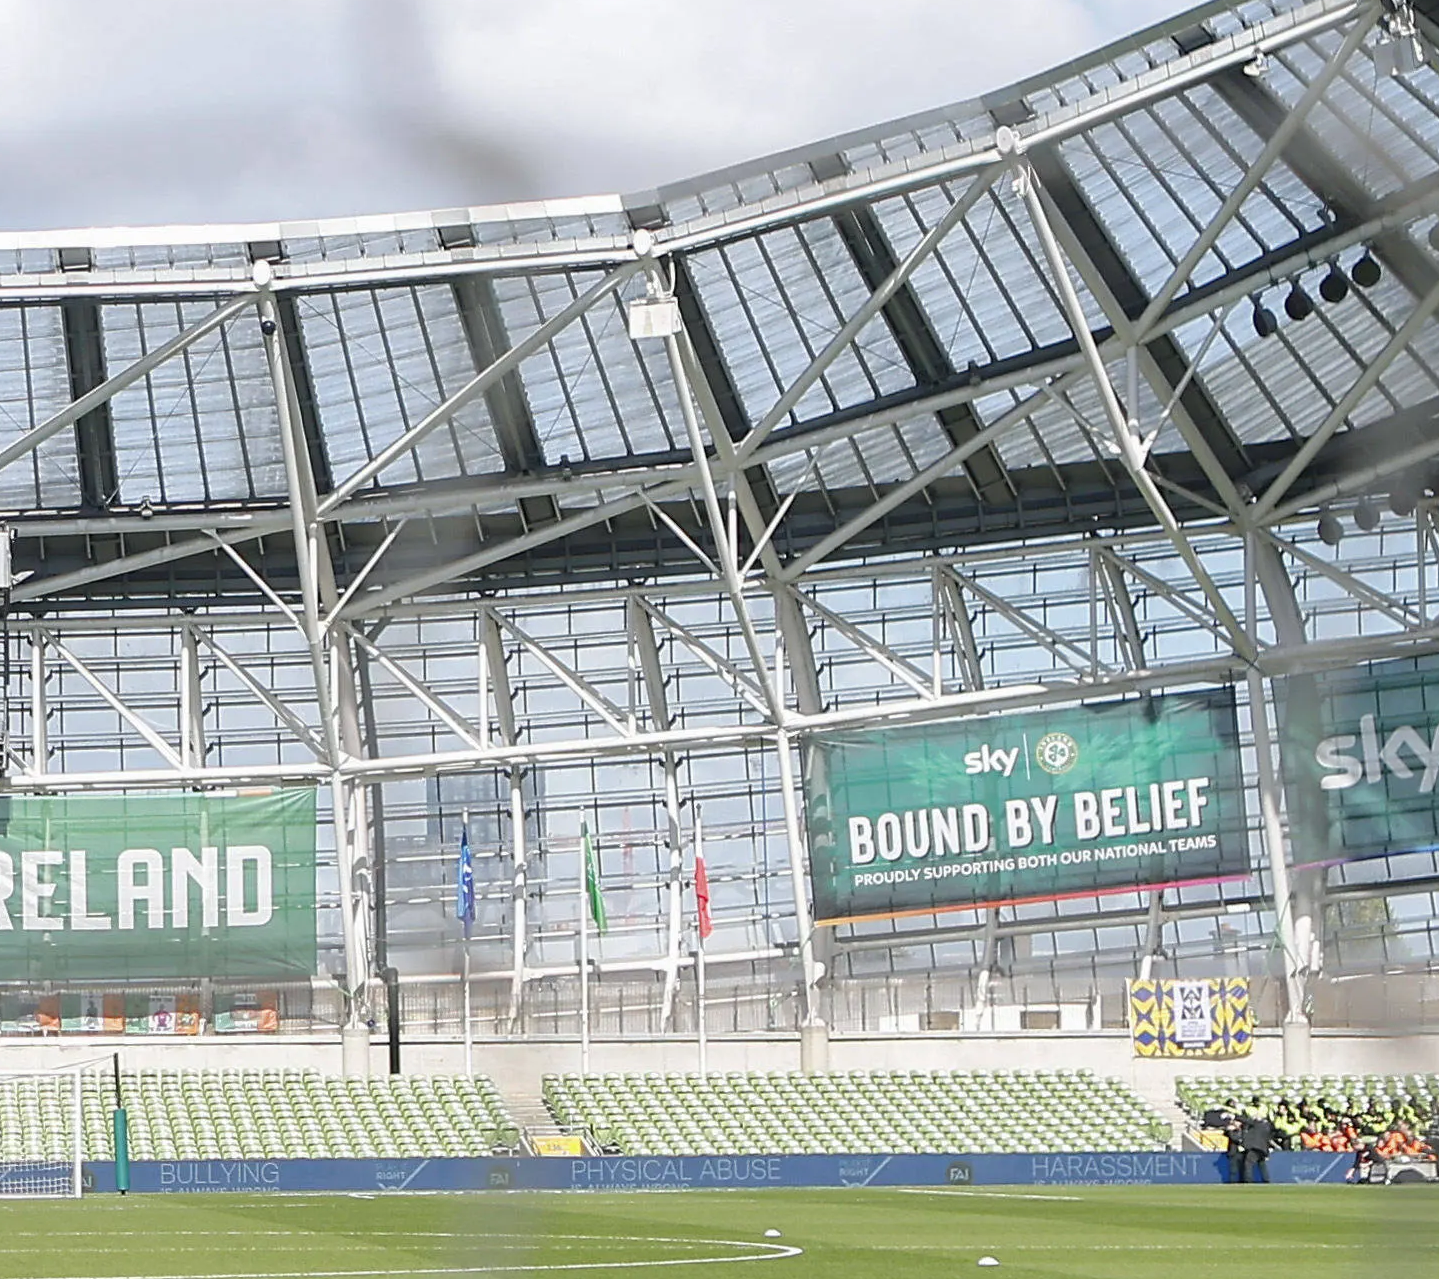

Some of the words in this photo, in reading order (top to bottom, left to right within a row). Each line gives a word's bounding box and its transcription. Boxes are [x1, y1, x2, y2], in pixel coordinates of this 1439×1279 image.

[965, 744, 1020, 777] sky
[847, 804, 991, 865] BOUND
[1005, 795, 1058, 849] BY
[1073, 777, 1210, 842] BELIEF
[854, 868, 922, 887] PROUDLY
[923, 858, 1015, 881] SUPPORTING
[1017, 853, 1058, 869] BOTH
[1060, 849, 1092, 863] OUR
[1093, 841, 1167, 860] NATIONAL
[1168, 834, 1217, 851] TEAMS
[161, 1162, 280, 1184] BULLYING
[376, 1171, 407, 1180] RIGHT
[571, 1159, 693, 1181] PHYSICAL
[700, 1159, 781, 1180] ABUSE
[1032, 1155, 1202, 1177] HARASSMENT
